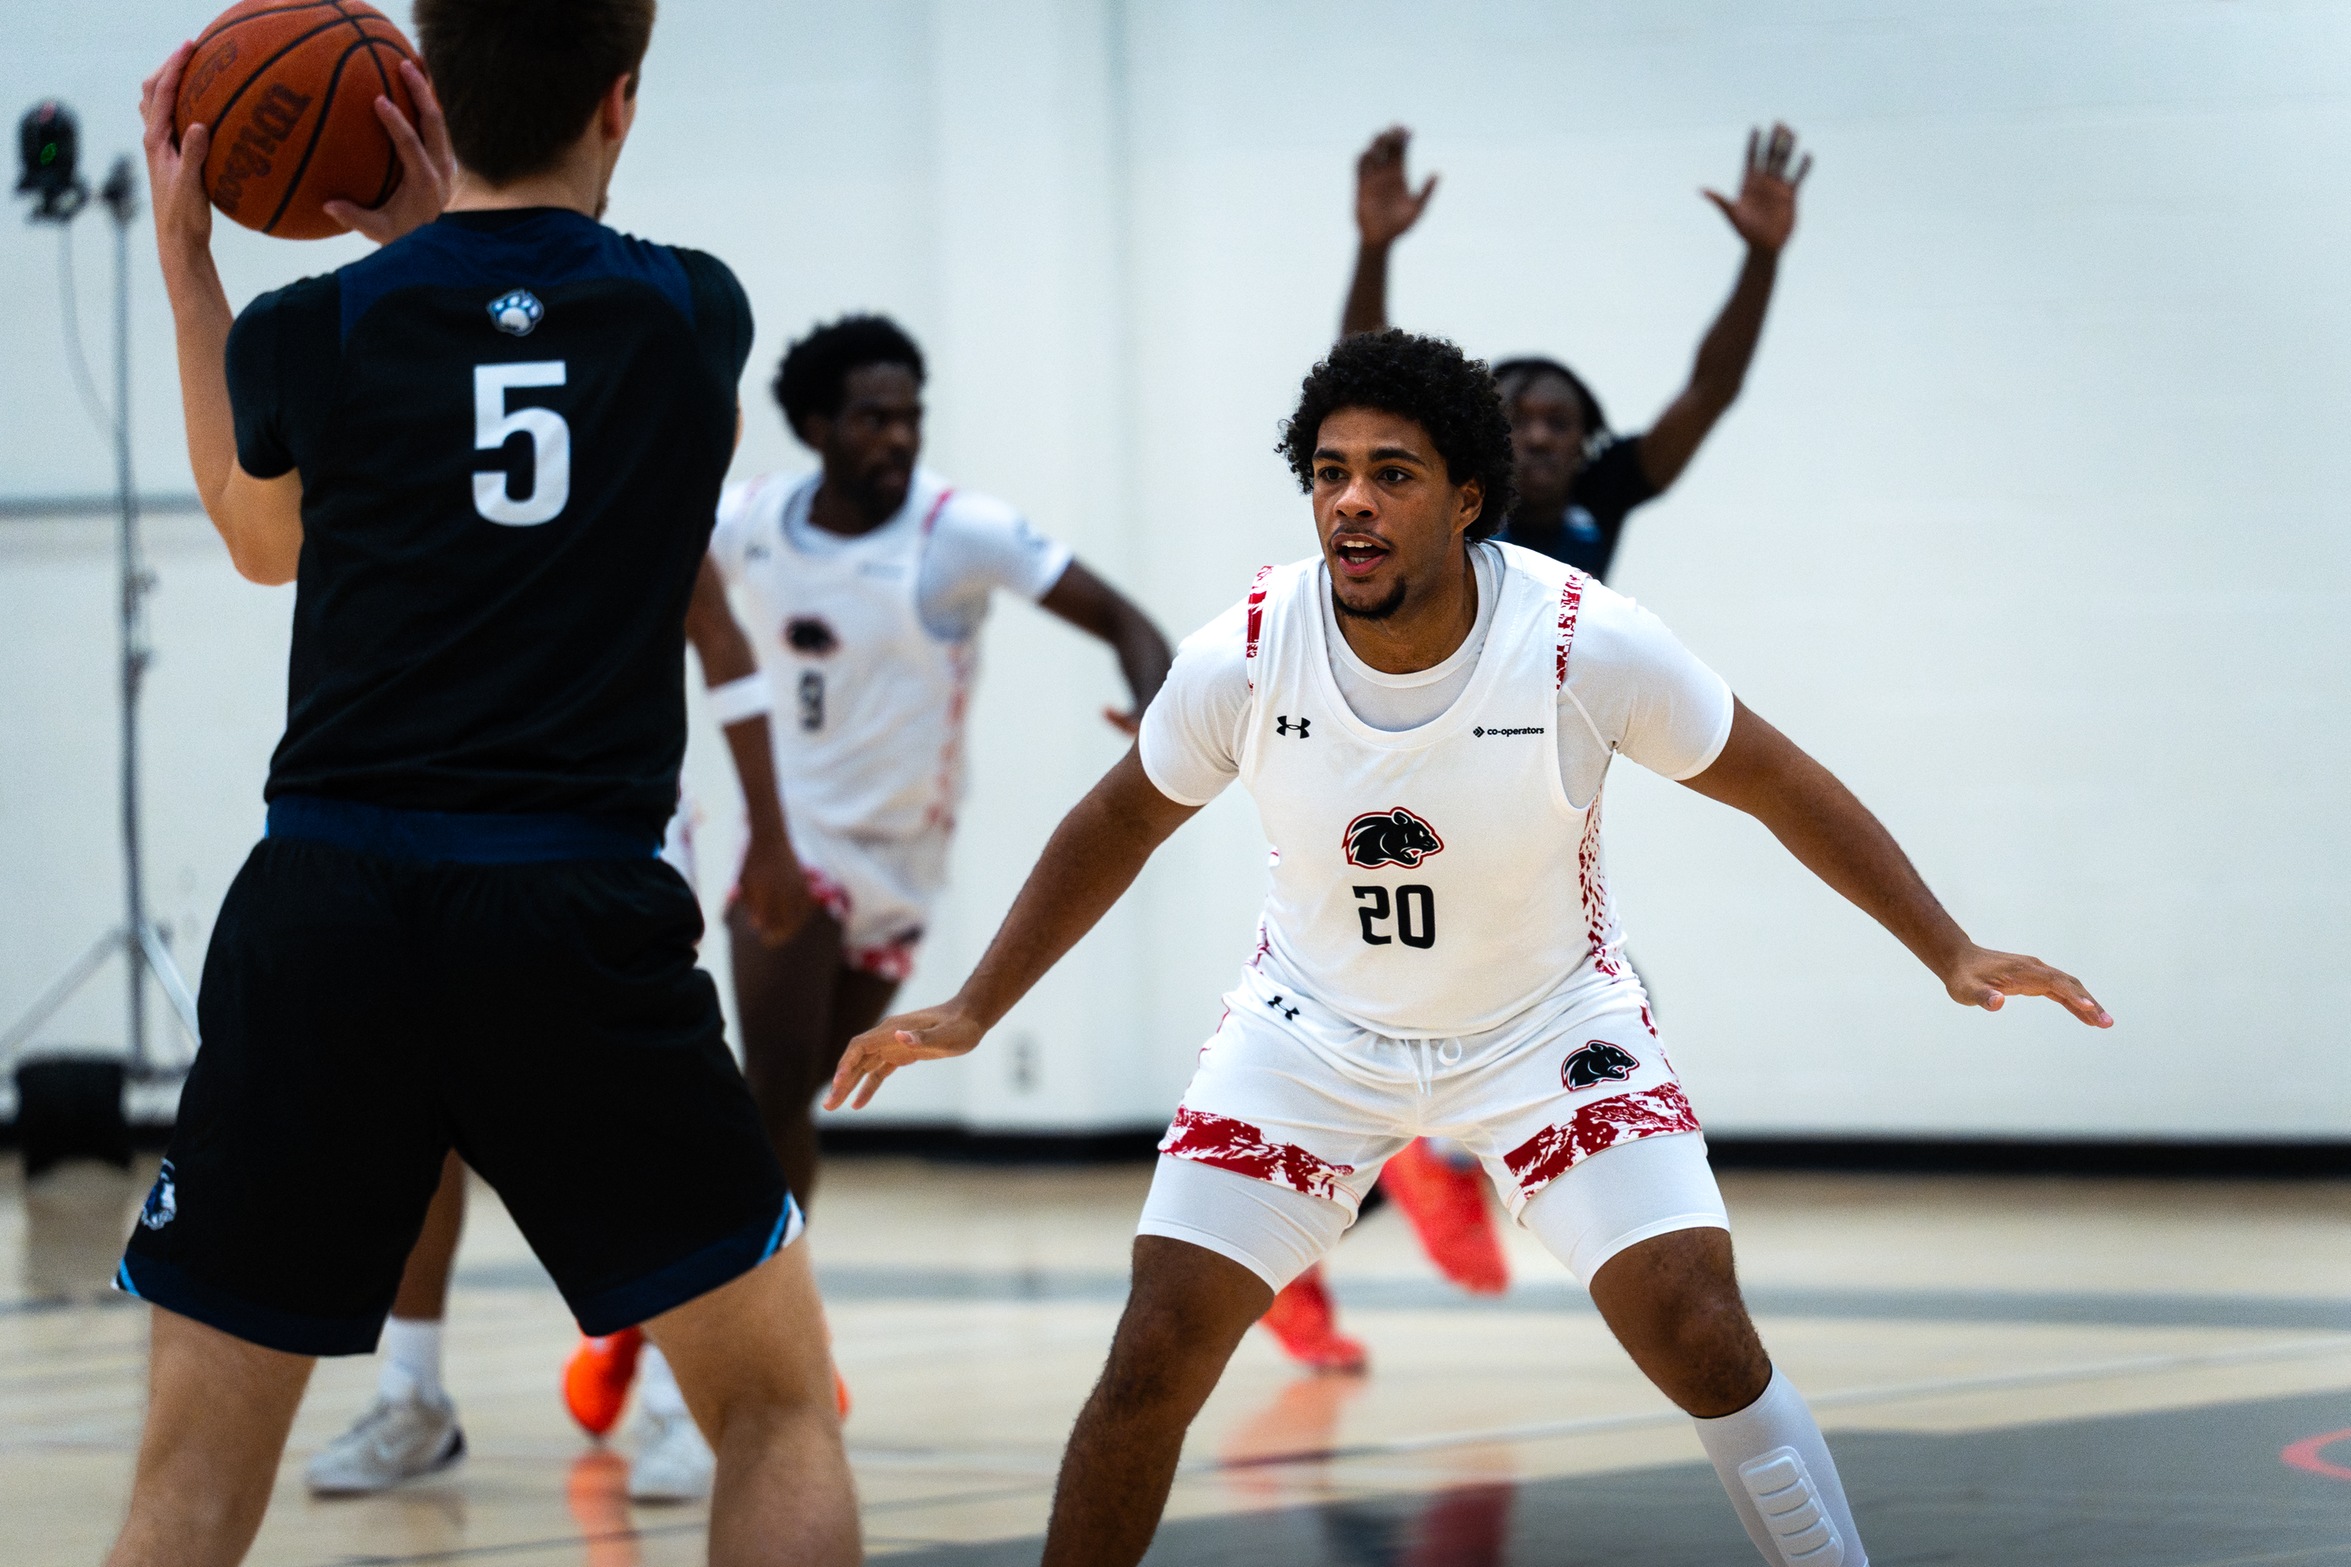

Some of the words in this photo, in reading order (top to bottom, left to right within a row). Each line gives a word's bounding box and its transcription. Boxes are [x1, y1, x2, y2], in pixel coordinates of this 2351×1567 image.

[472, 360, 570, 527] 5
[1487, 726, 1544, 737] co-operators
[1352, 884, 1435, 949] 20
